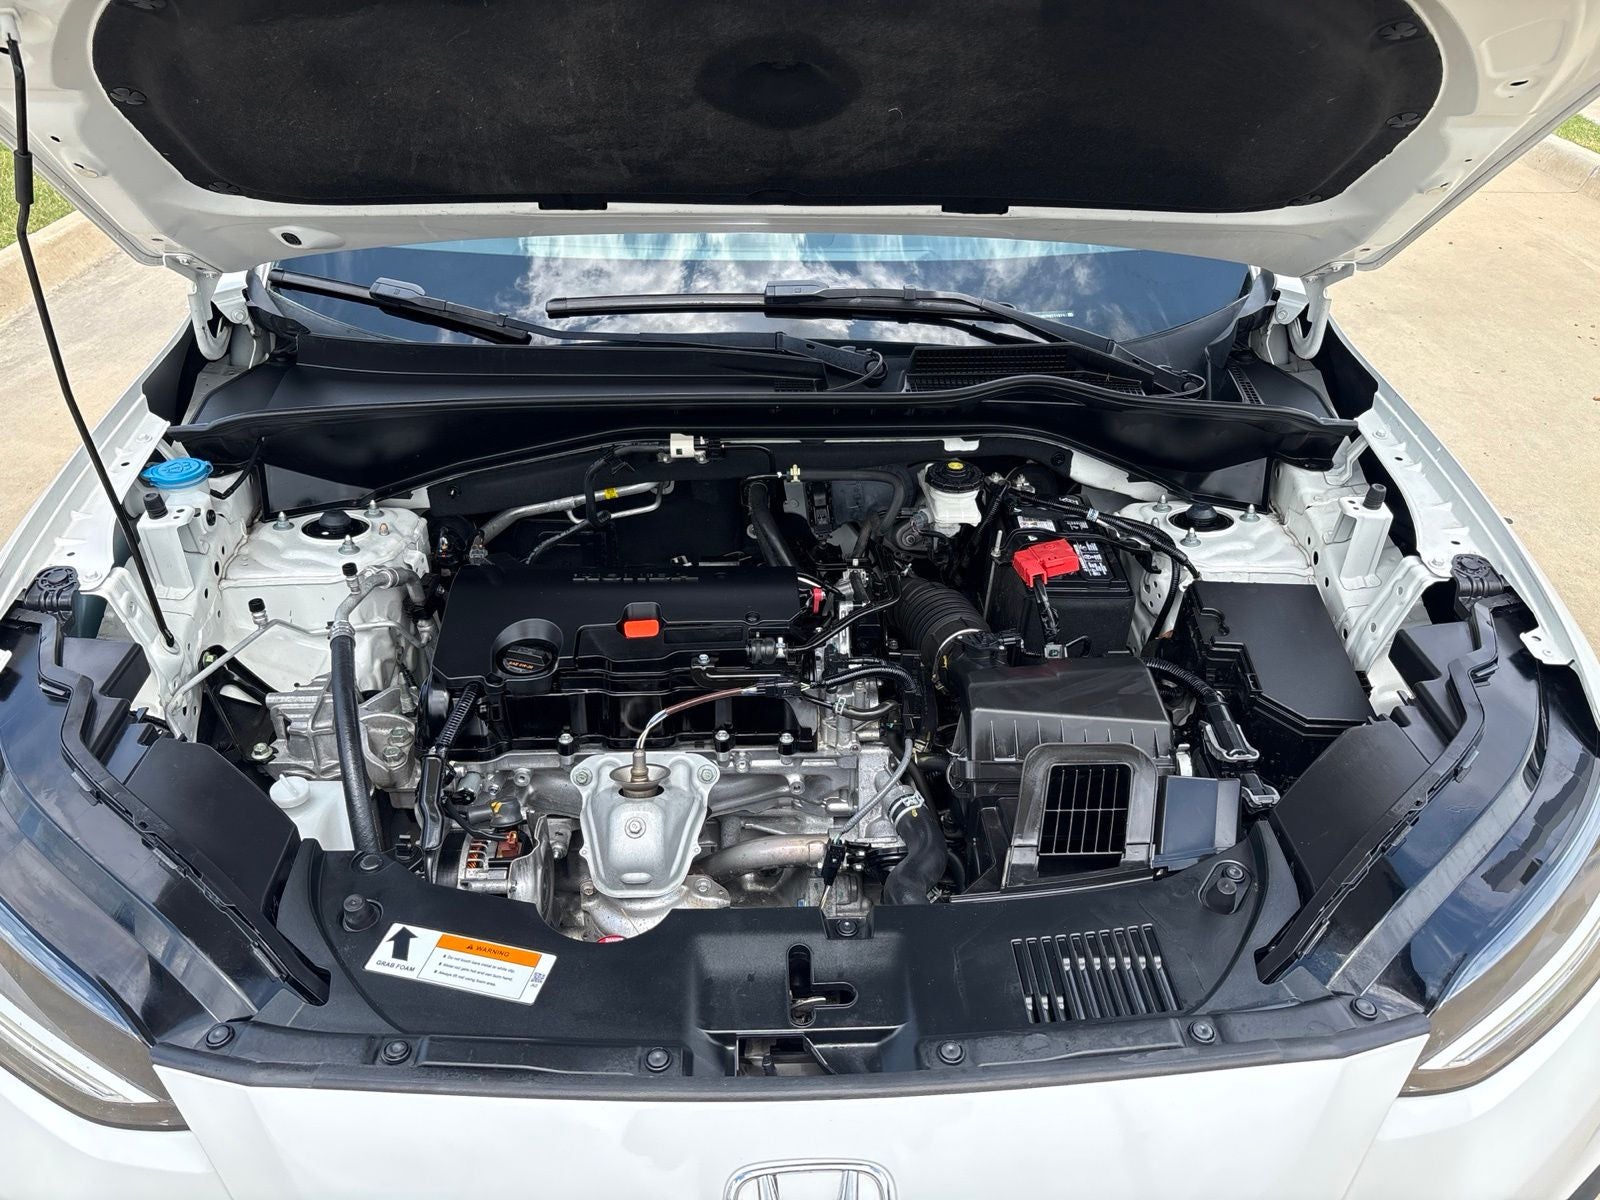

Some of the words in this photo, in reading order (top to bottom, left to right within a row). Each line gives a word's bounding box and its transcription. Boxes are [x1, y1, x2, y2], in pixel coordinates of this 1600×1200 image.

[476, 946, 510, 958] WARNING
[376, 959, 395, 968] GRAB
[395, 963, 416, 973] FOAM
